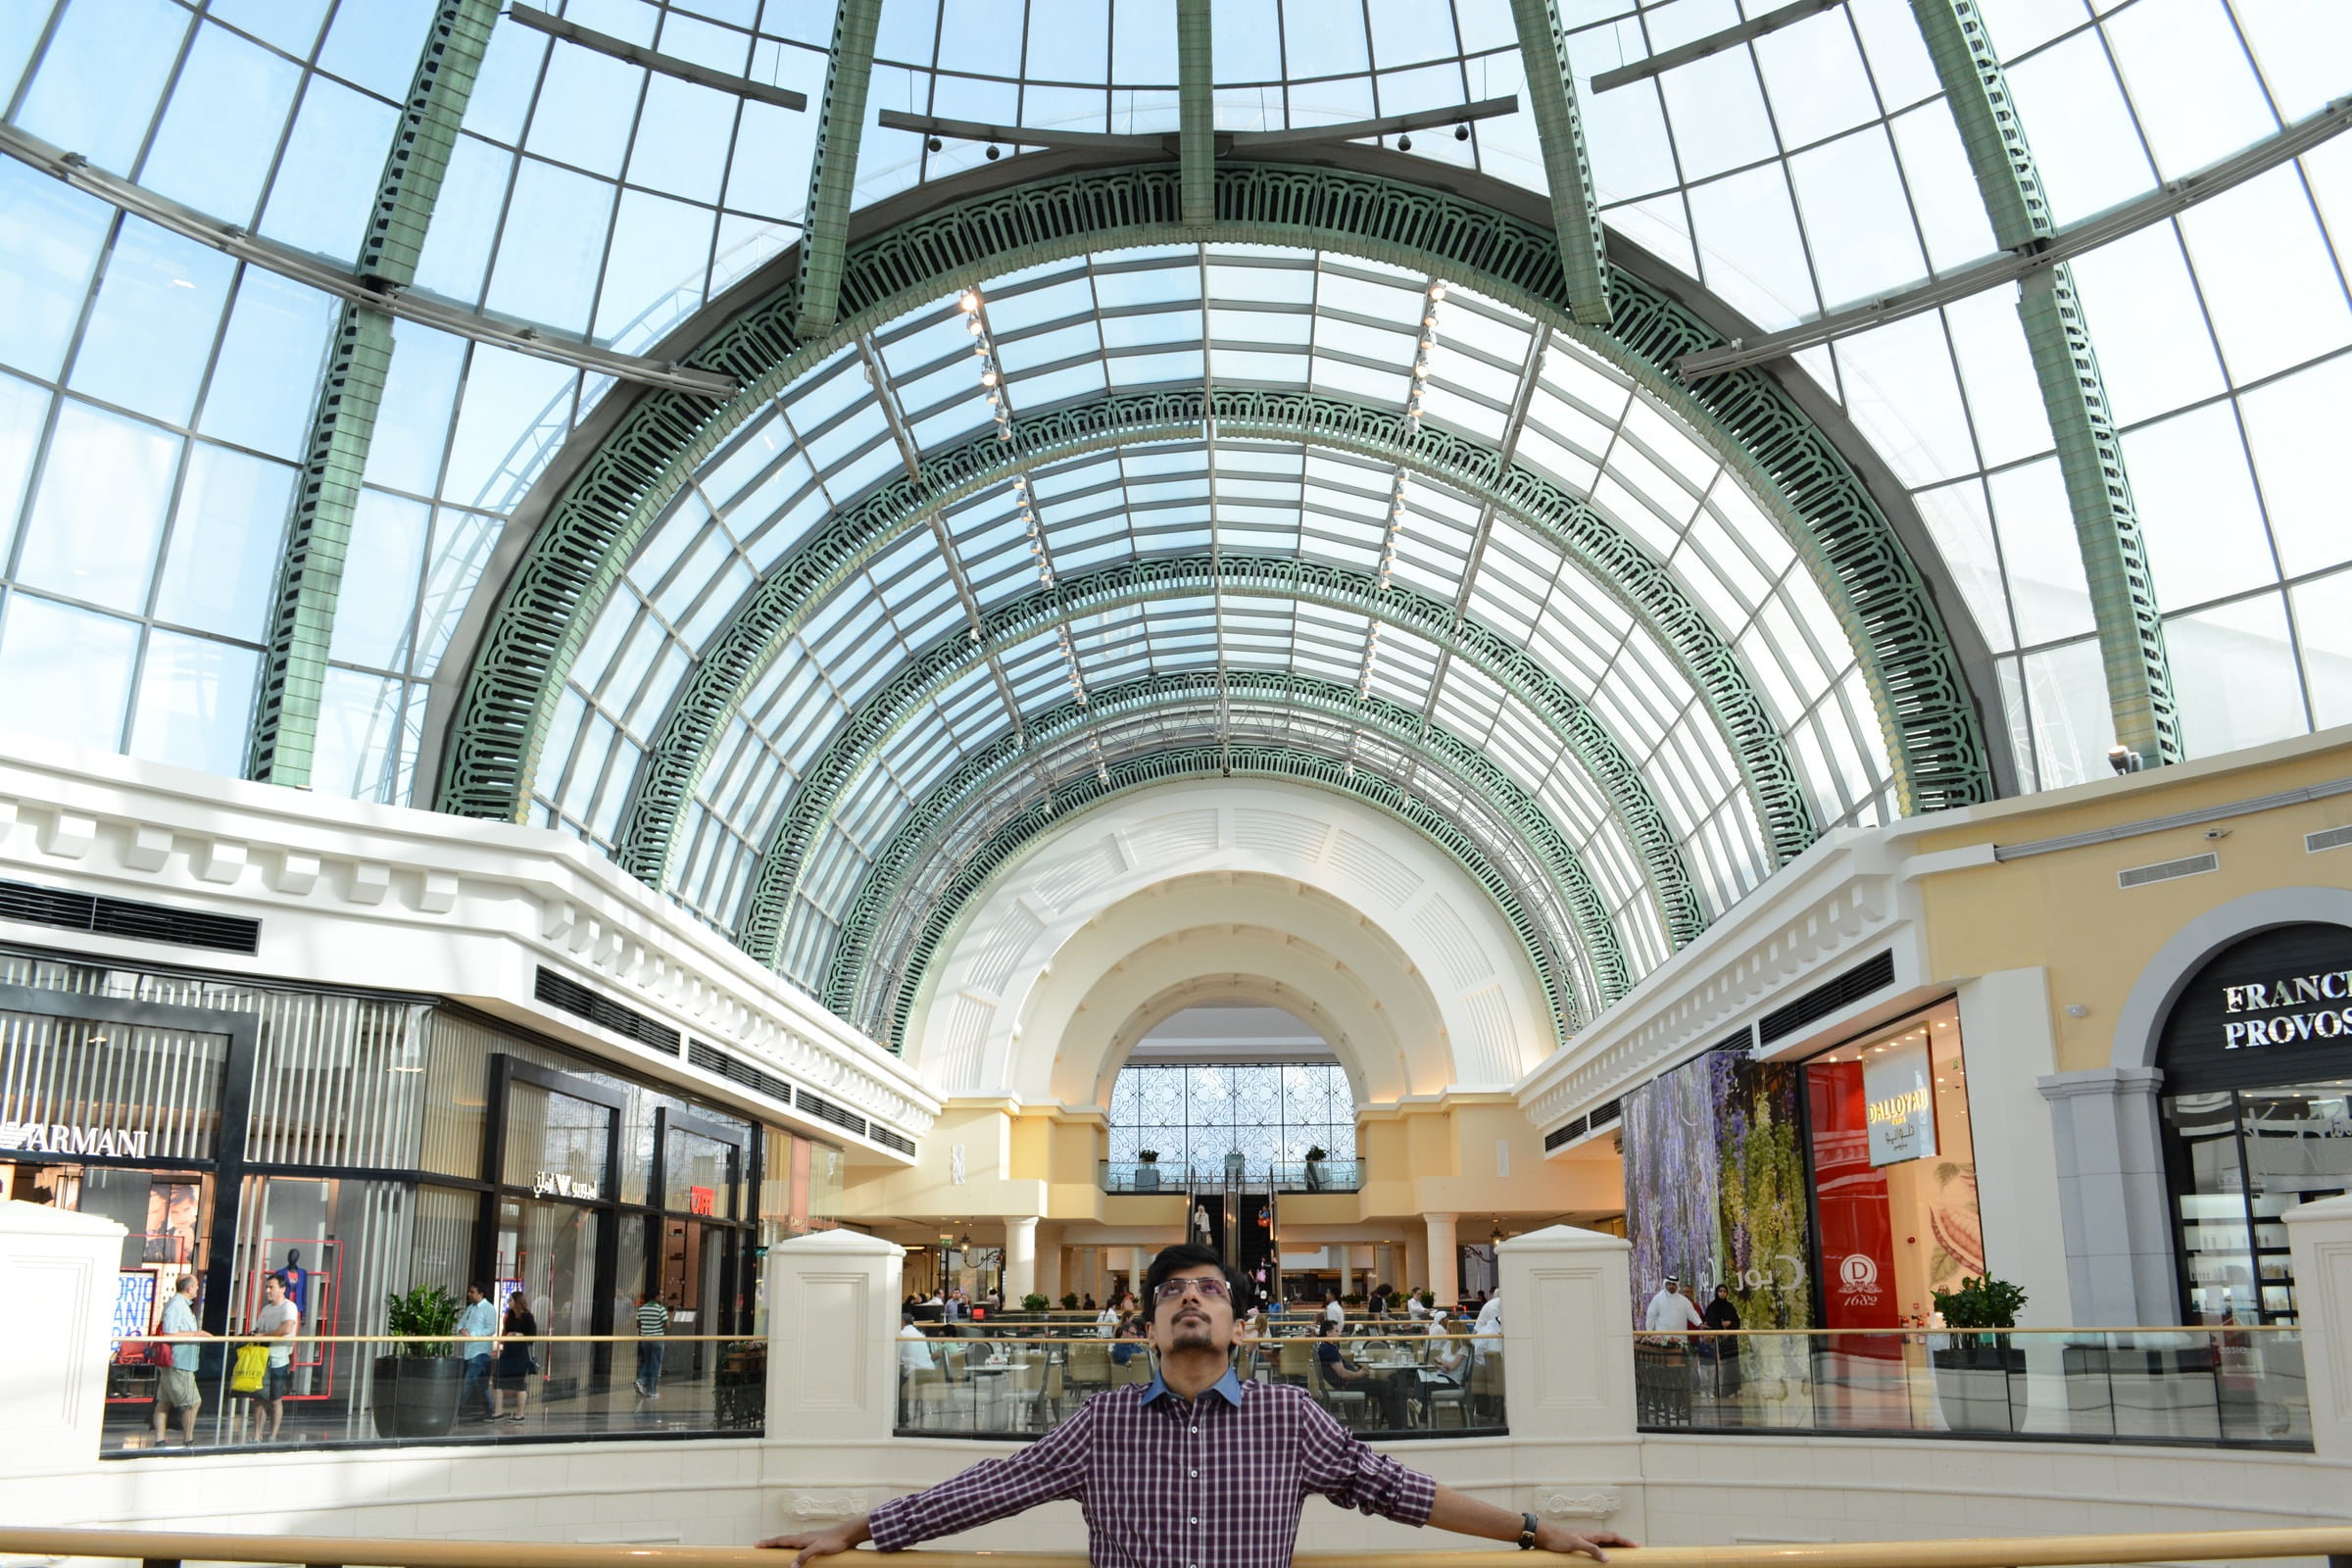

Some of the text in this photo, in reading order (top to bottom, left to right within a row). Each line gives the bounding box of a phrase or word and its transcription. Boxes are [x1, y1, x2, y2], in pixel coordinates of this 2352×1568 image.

[1869, 1088, 1929, 1124] DALLOYAU
[26, 1123, 148, 1158] ARMANI
[1851, 1260, 1868, 1280] D
[1843, 1294, 1878, 1307] 1682
